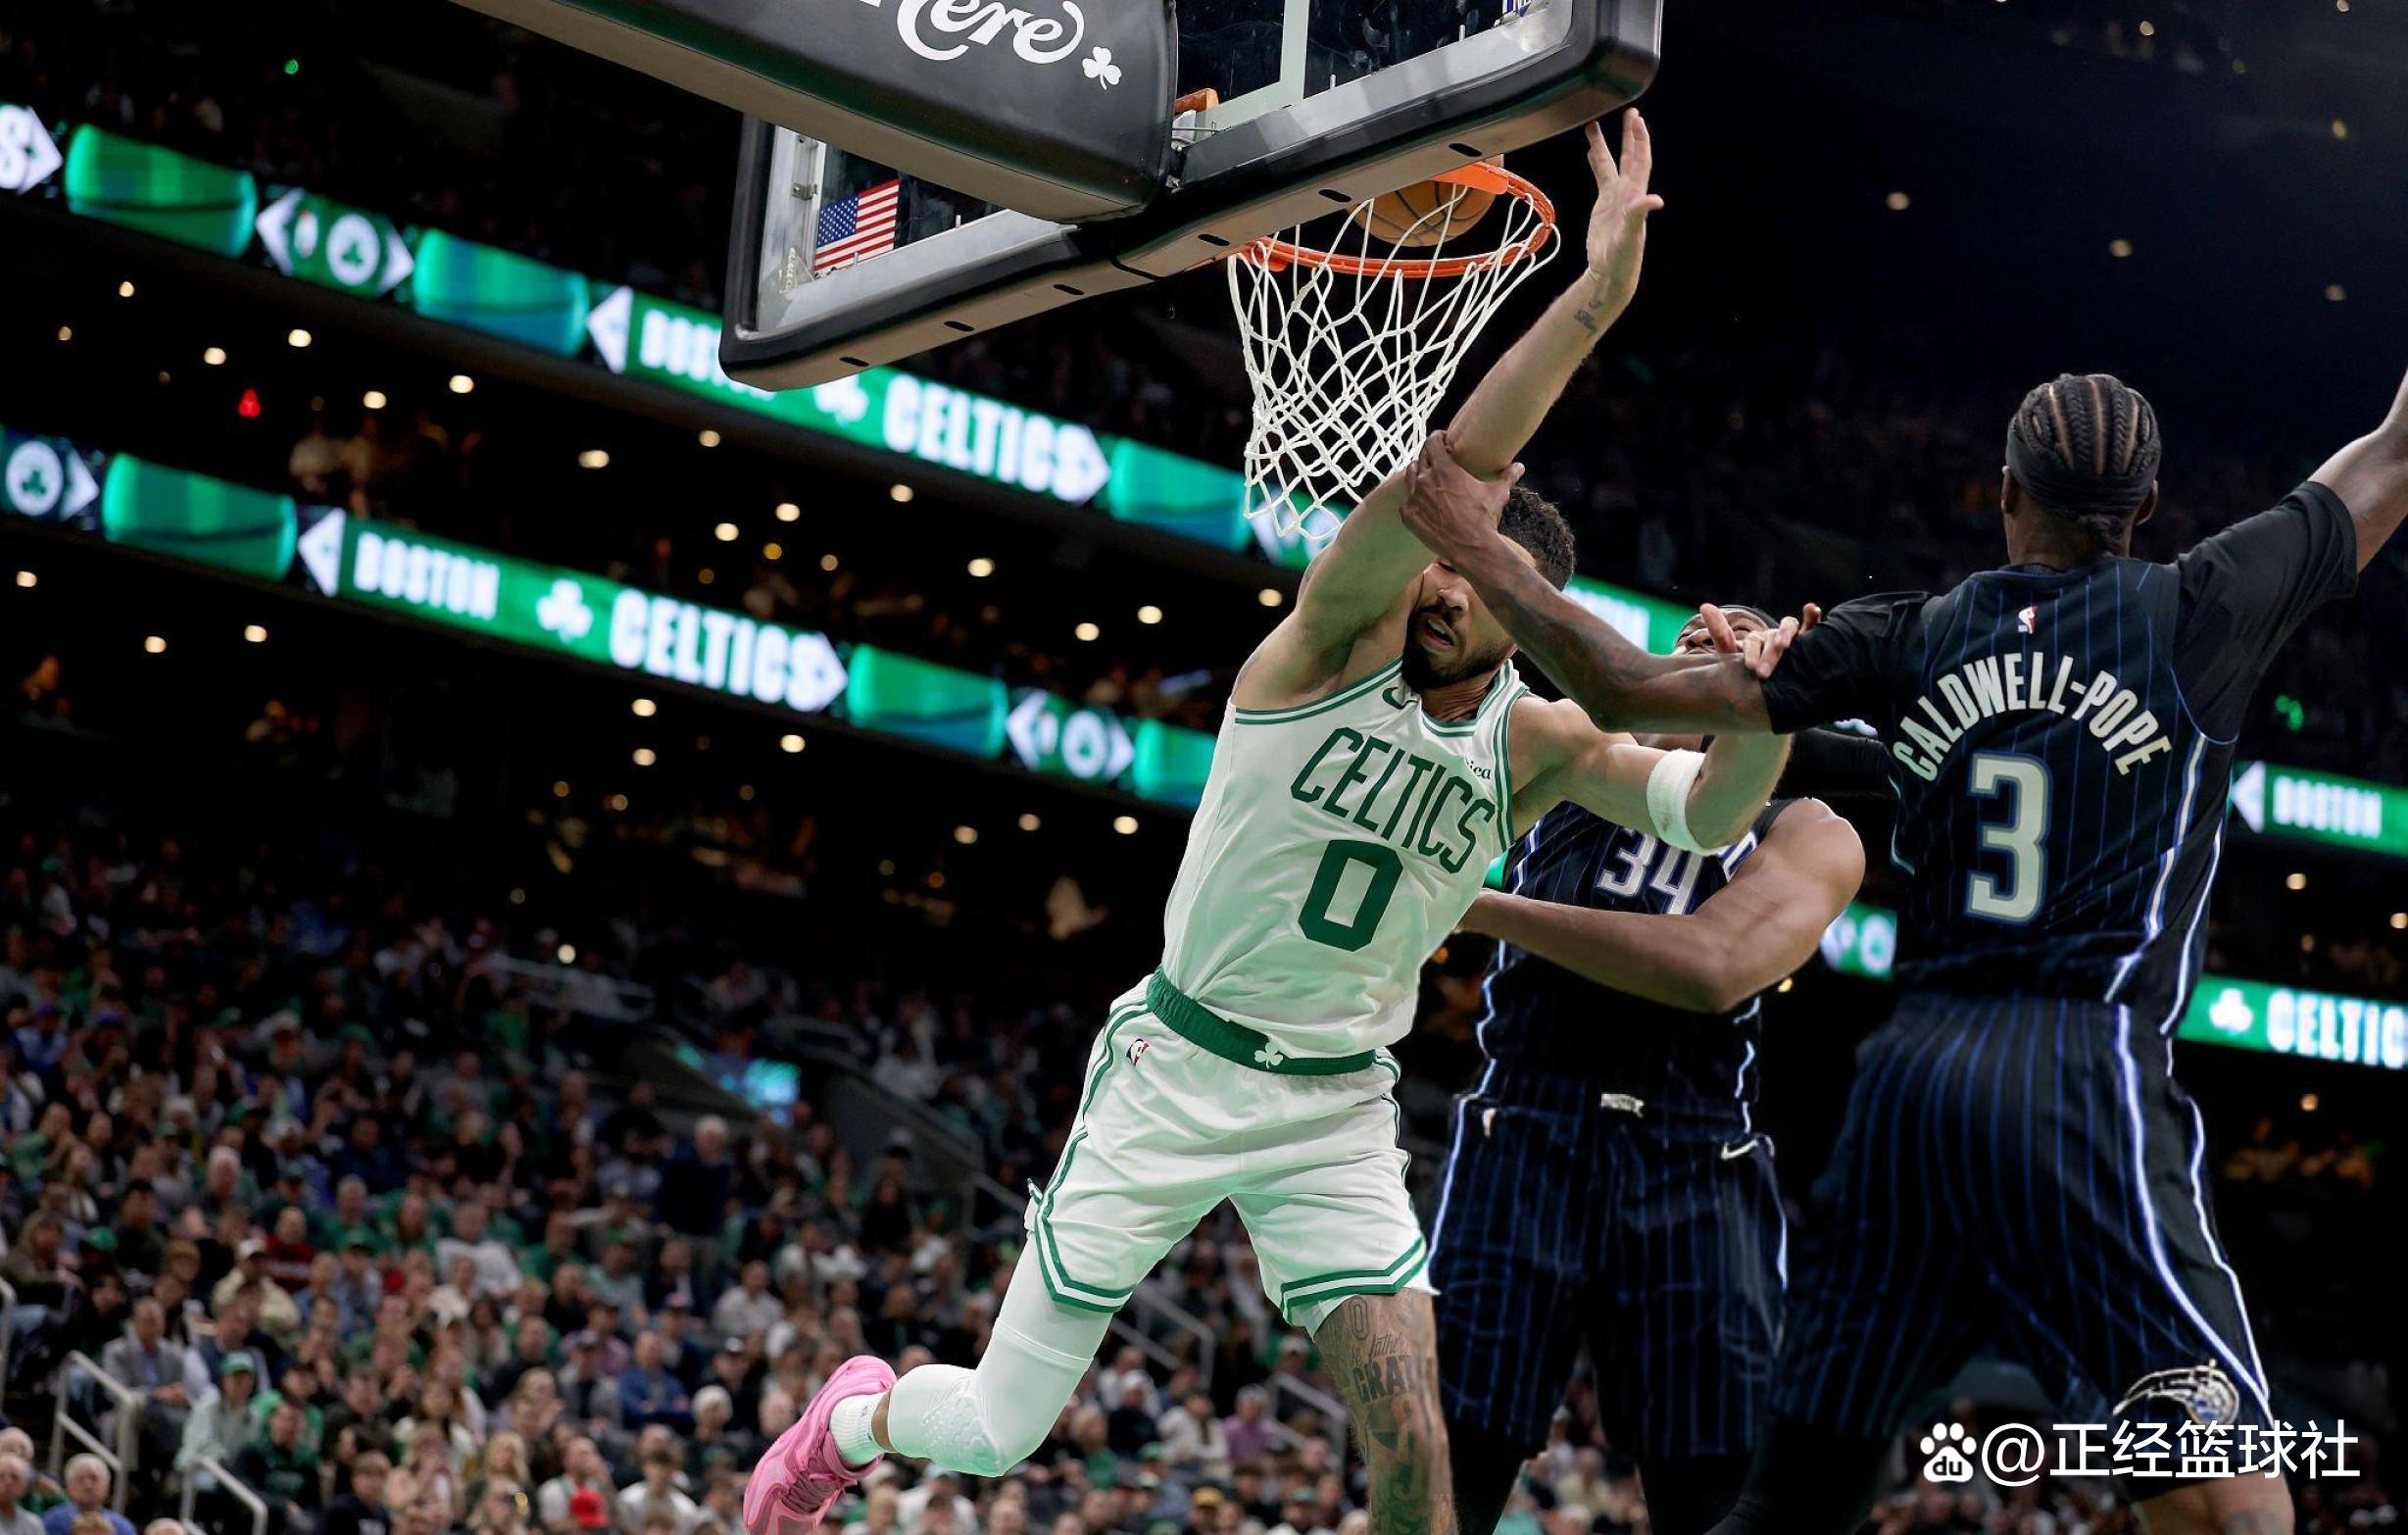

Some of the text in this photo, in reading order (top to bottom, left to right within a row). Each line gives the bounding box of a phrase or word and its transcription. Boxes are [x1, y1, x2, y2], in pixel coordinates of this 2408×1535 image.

[884, 373, 1093, 502] CELTICS
[354, 531, 825, 713] BOSTON CELTICS
[1892, 651, 2173, 782] CALDWELL-POPE
[1290, 726, 1496, 874] CELTICS
[1966, 753, 2052, 924] 3
[2273, 775, 2383, 839] BOSTON
[1298, 839, 1403, 952] 0
[1597, 829, 1703, 916] 34
[2267, 988, 2408, 1069] CELTIC
